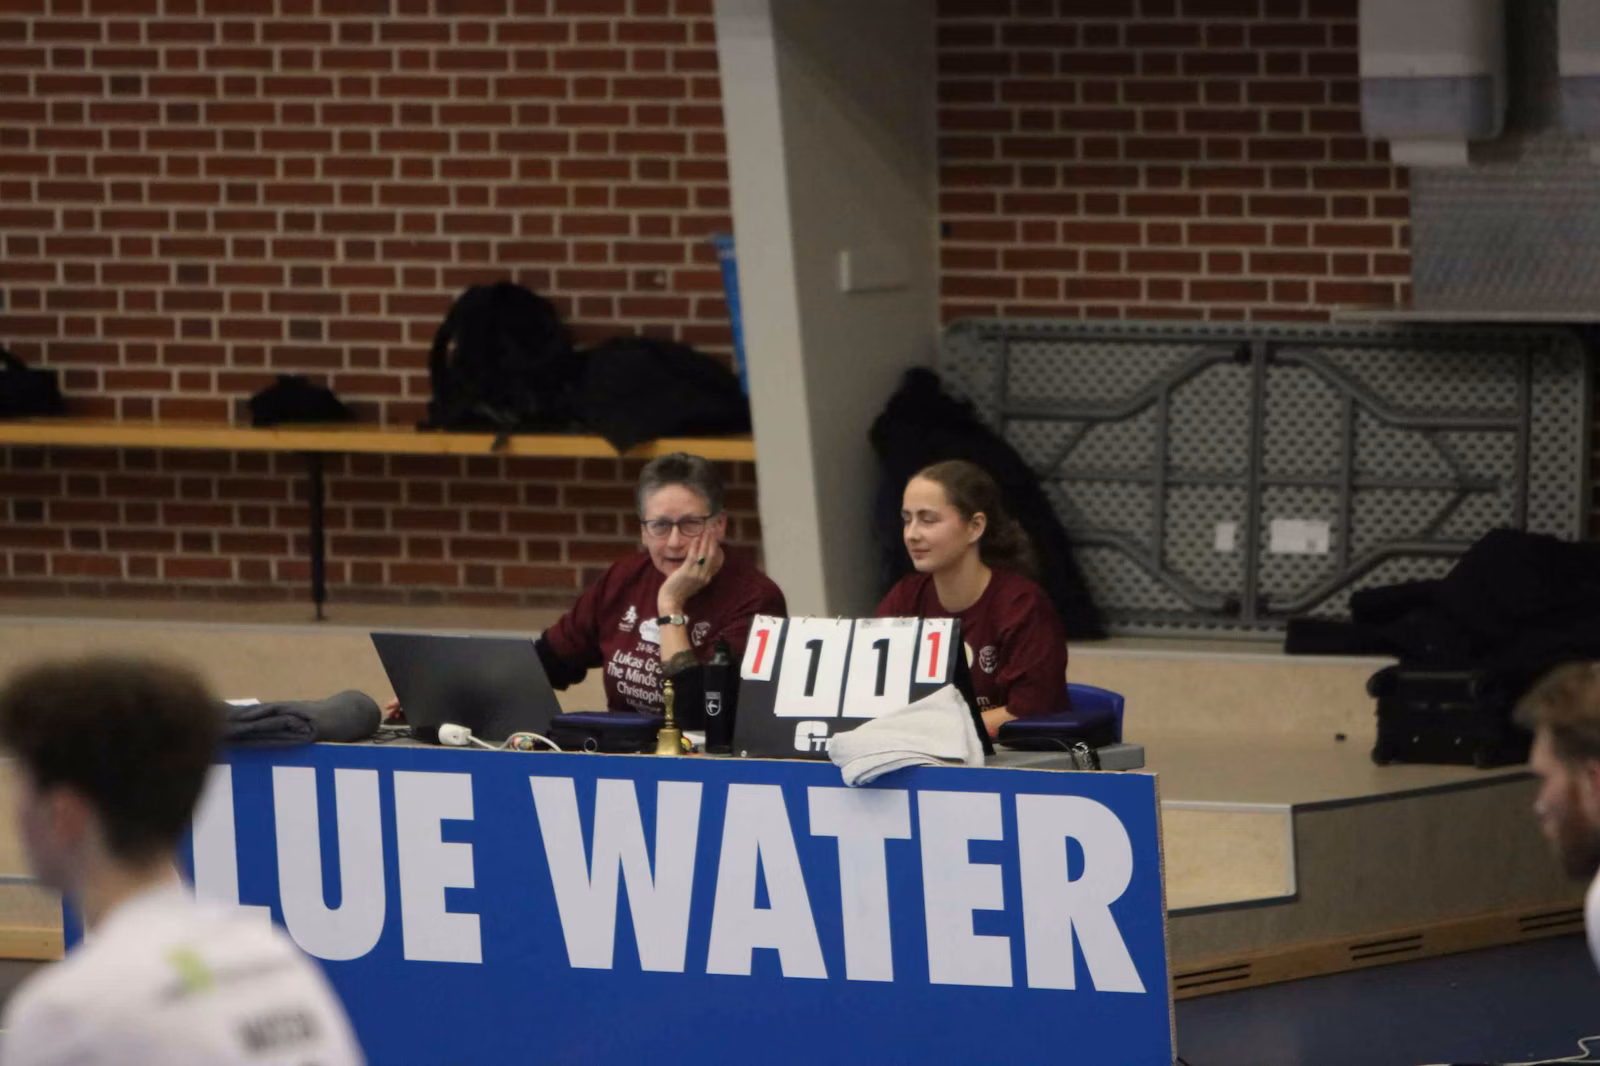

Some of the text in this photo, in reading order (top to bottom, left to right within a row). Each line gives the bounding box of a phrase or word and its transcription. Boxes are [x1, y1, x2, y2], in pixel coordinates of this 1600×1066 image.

[607, 662, 624, 678] The
[625, 668, 657, 687] Minds
[612, 649, 644, 669] Lukas
[752, 629, 941, 697] 1 1 1 1
[189, 763, 1147, 994] LUE WATER
